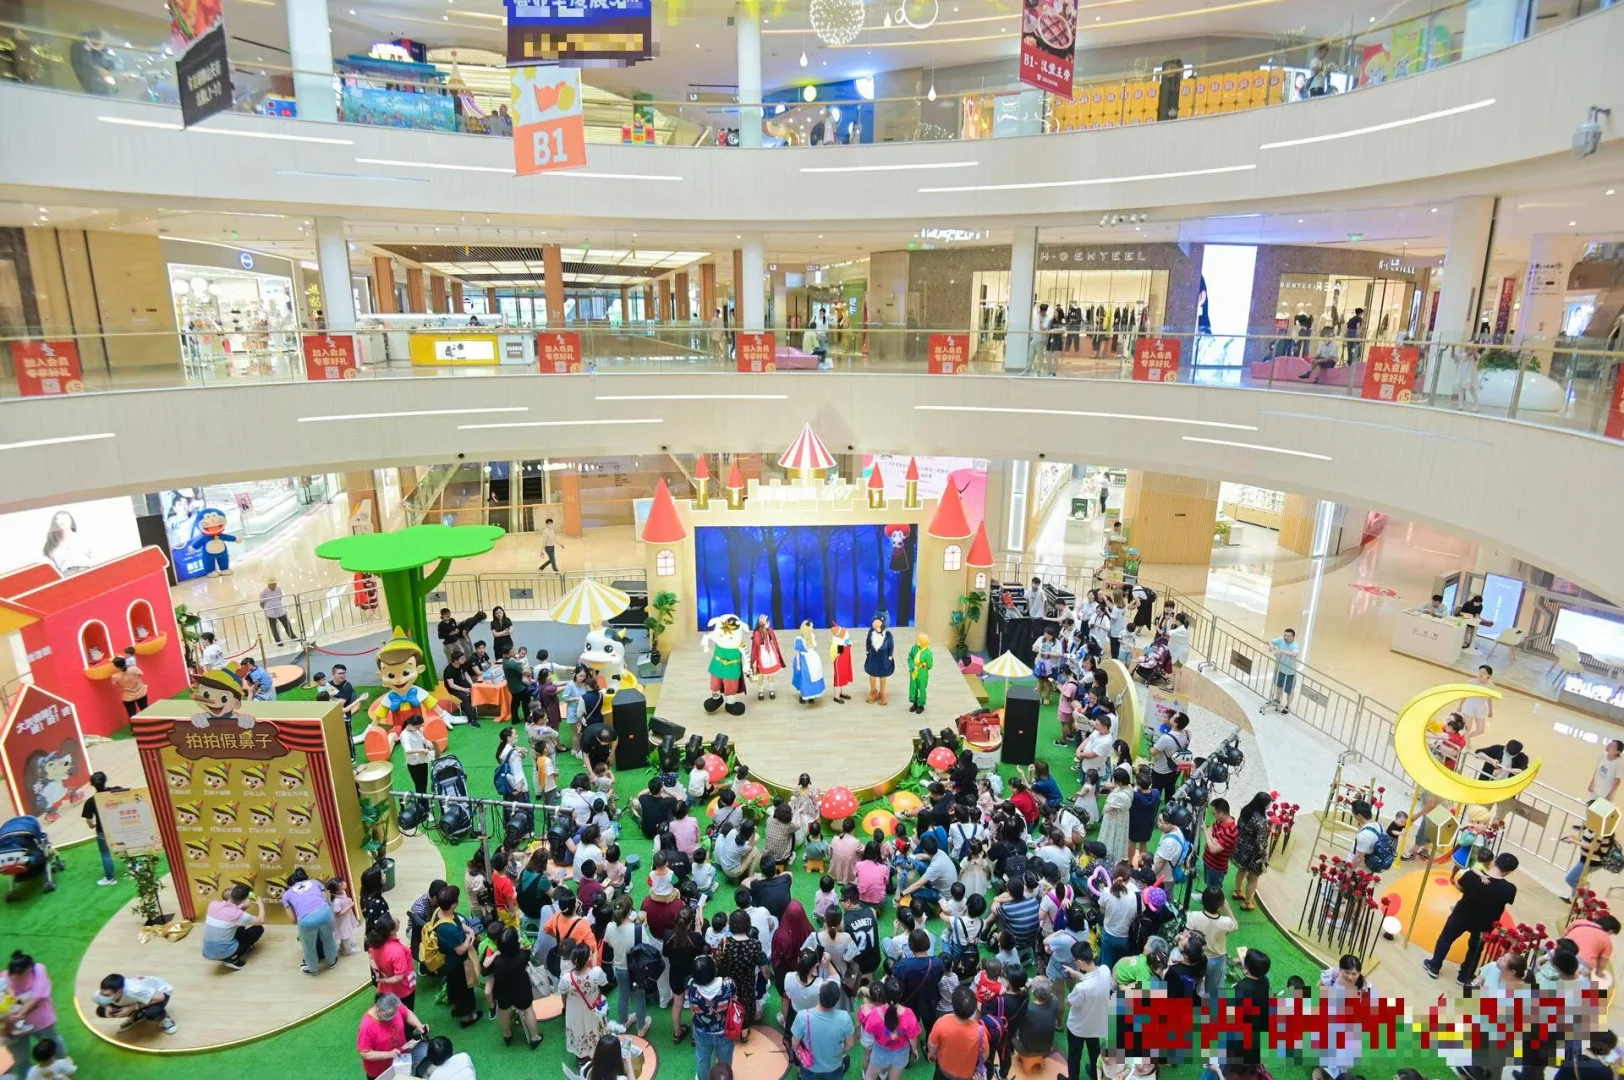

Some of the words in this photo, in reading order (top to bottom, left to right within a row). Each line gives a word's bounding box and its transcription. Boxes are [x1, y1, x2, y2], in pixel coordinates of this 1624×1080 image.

[533, 127, 568, 166] B1
[185, 732, 272, 749] 拍拍假鼻子
[853, 926, 875, 950] 21
